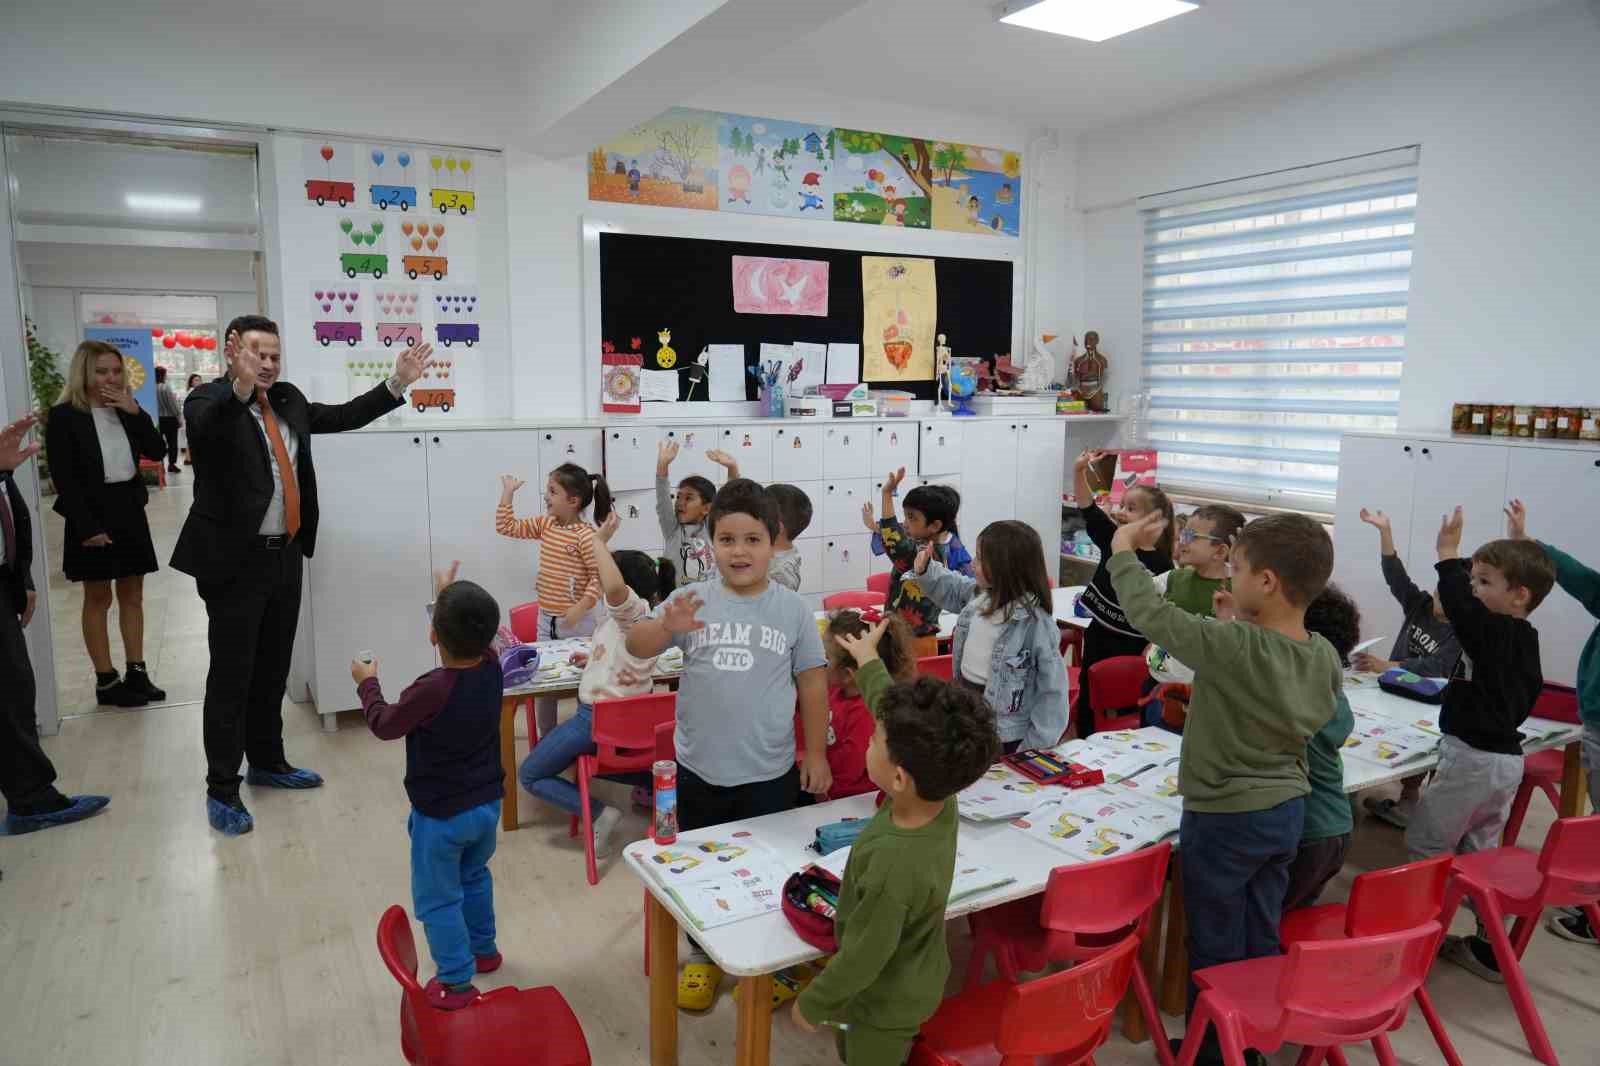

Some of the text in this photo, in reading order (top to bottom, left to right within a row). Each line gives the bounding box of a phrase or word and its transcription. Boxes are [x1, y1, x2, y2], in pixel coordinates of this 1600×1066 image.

[389, 190, 400, 203] 2
[448, 194, 459, 208] 3
[360, 258, 370, 271] 4
[421, 260, 432, 274] 5
[395, 327, 407, 340] 7
[427, 393, 444, 406] 10
[760, 626, 787, 656] BIG
[718, 652, 749, 666] NYC
